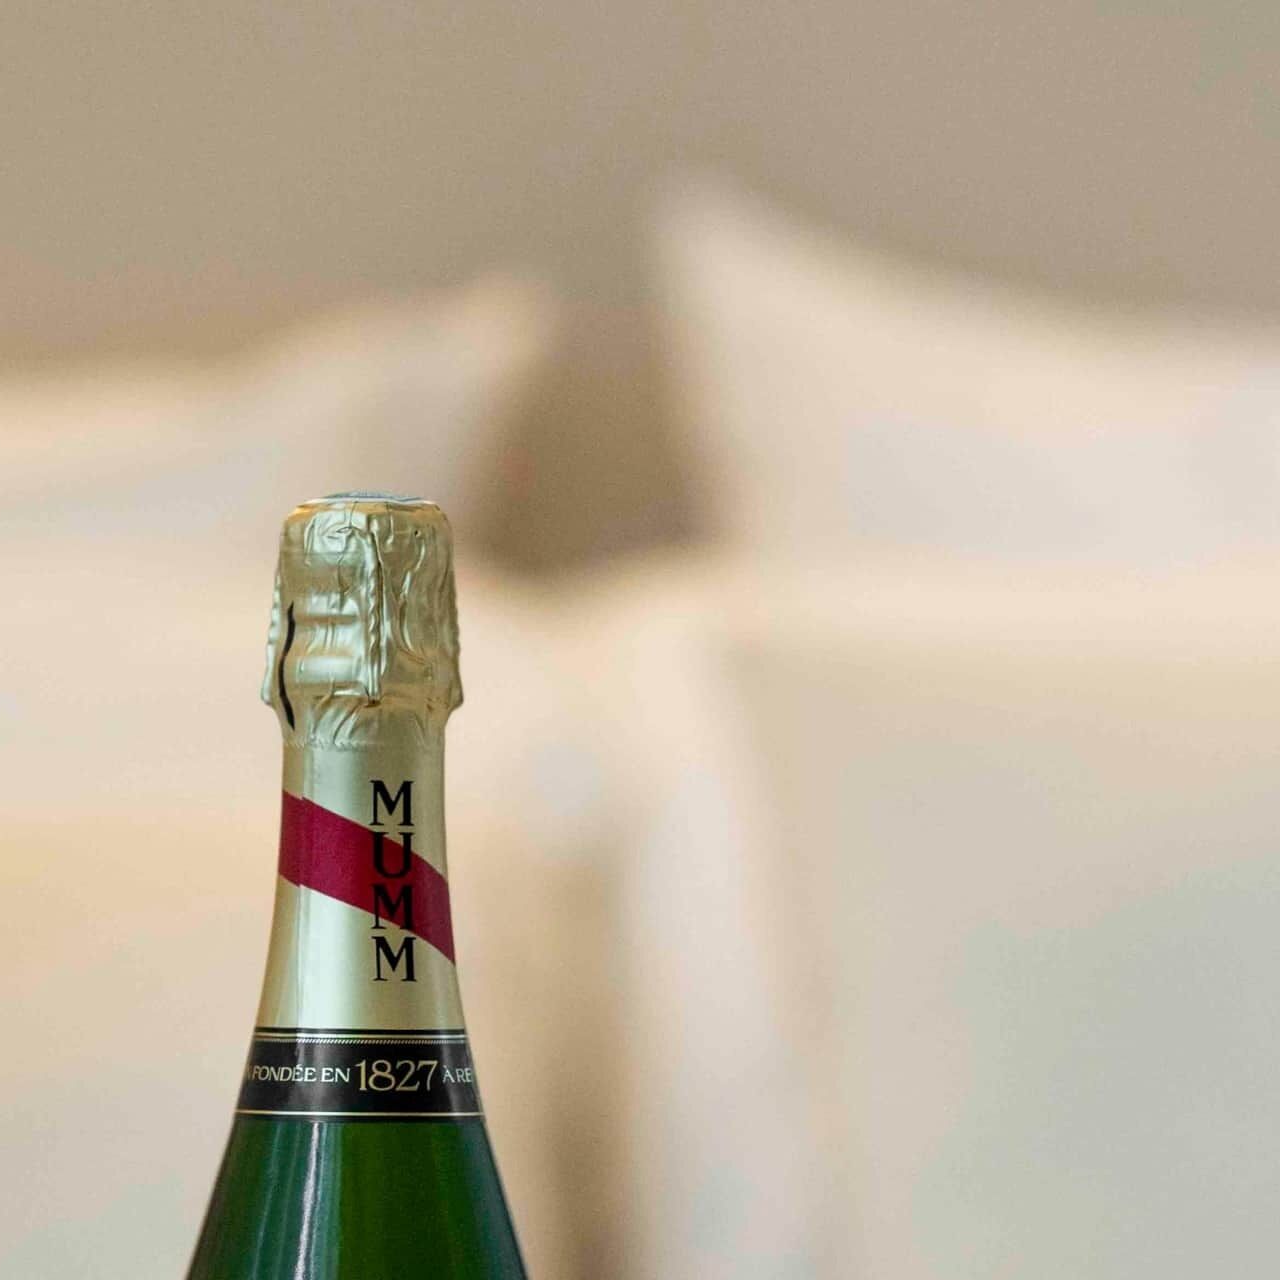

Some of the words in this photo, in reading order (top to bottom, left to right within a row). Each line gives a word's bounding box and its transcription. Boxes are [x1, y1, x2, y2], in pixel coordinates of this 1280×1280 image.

[370, 779, 417, 982] MUMM
[252, 1064, 317, 1083] FONDÉE
[321, 1067, 351, 1083] EN
[355, 1059, 438, 1092] 1827
